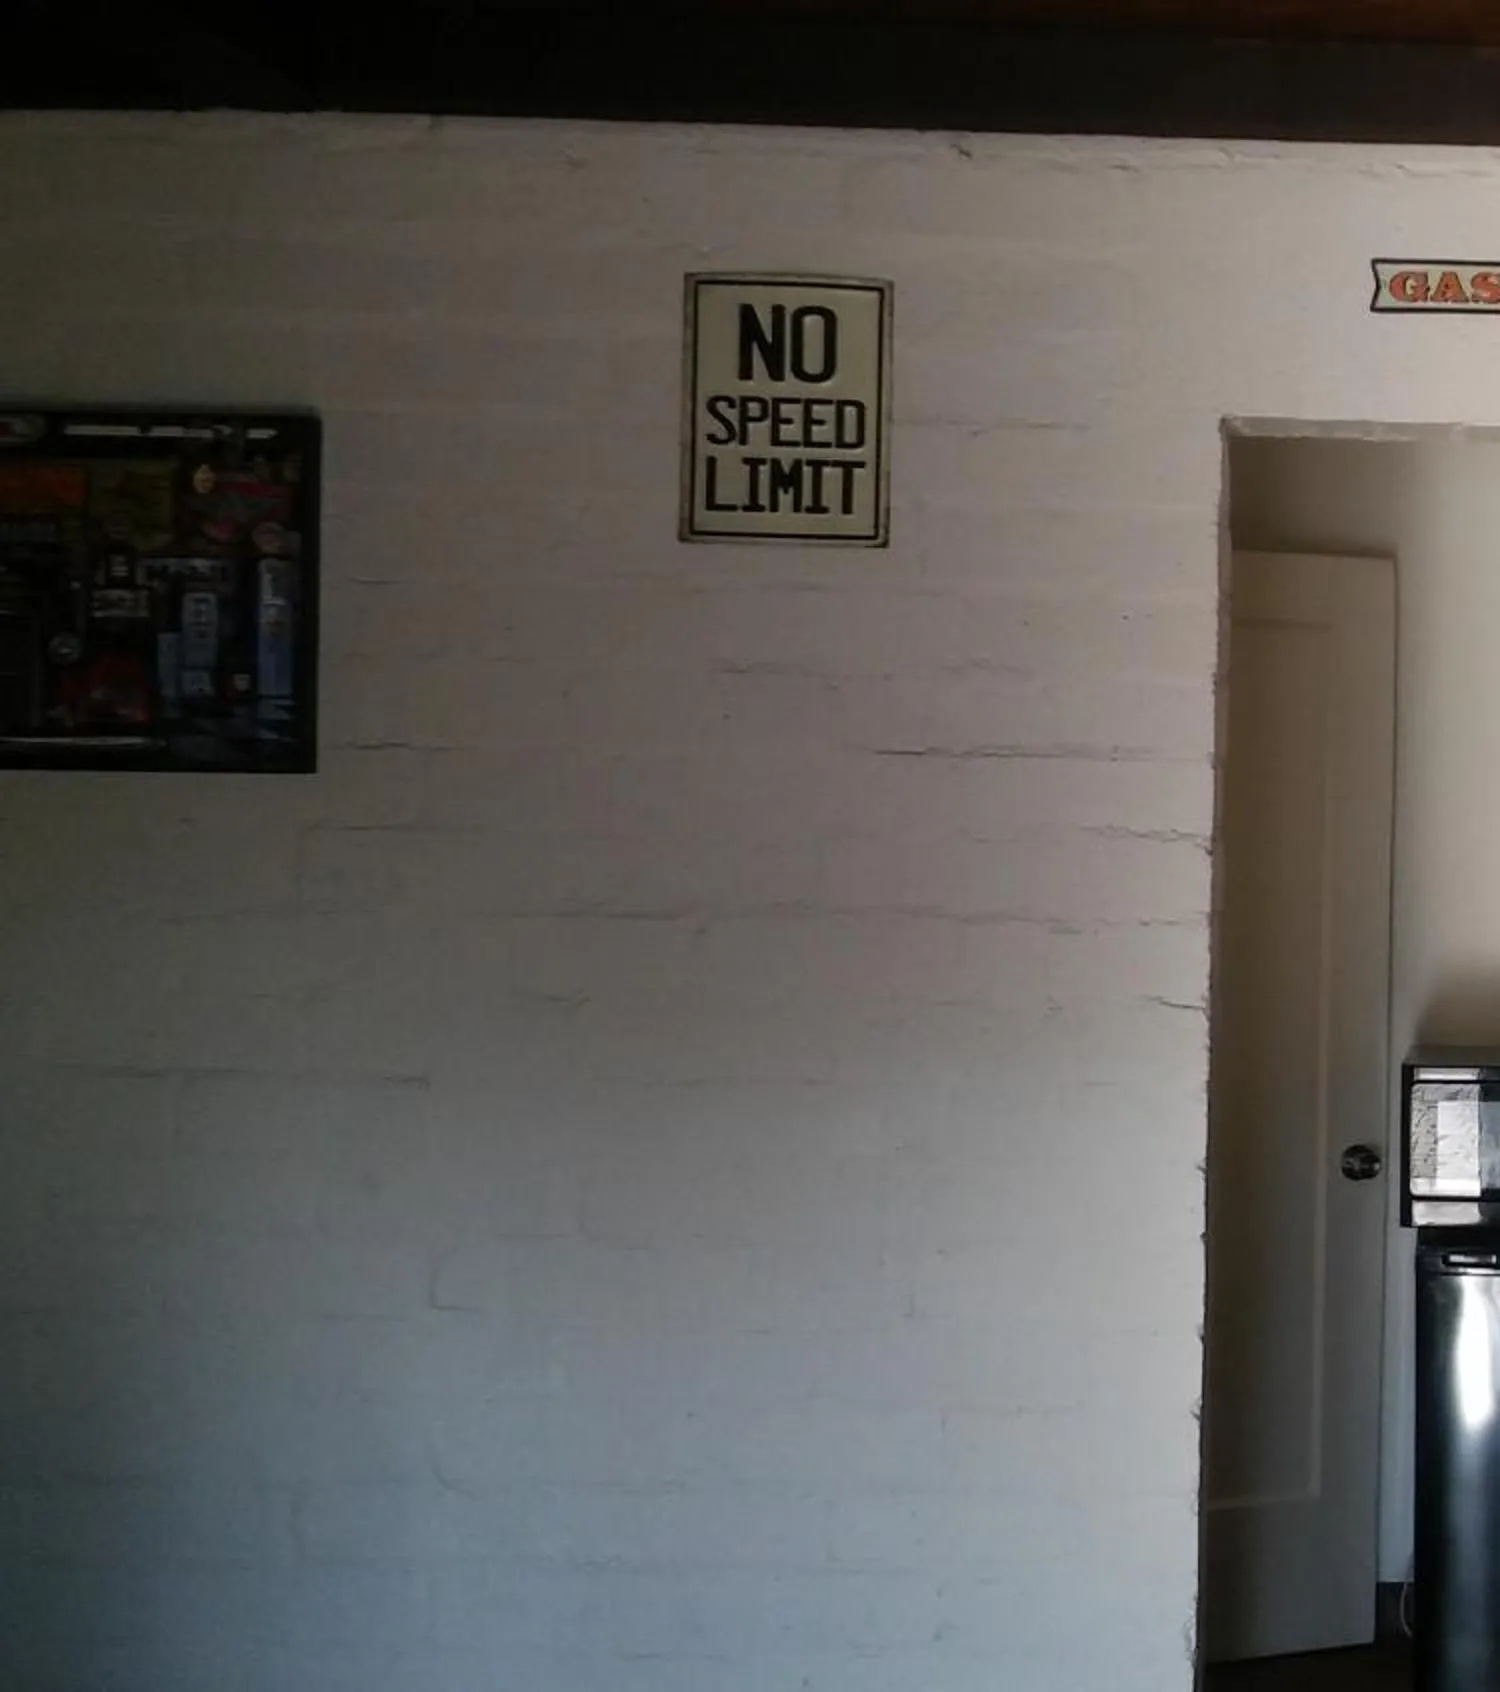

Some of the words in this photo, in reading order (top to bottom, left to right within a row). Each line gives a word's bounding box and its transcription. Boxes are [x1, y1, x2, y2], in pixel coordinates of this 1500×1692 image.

[738, 303, 838, 383] NO
[705, 395, 866, 449] SPEED
[705, 455, 866, 514] LIMIT
